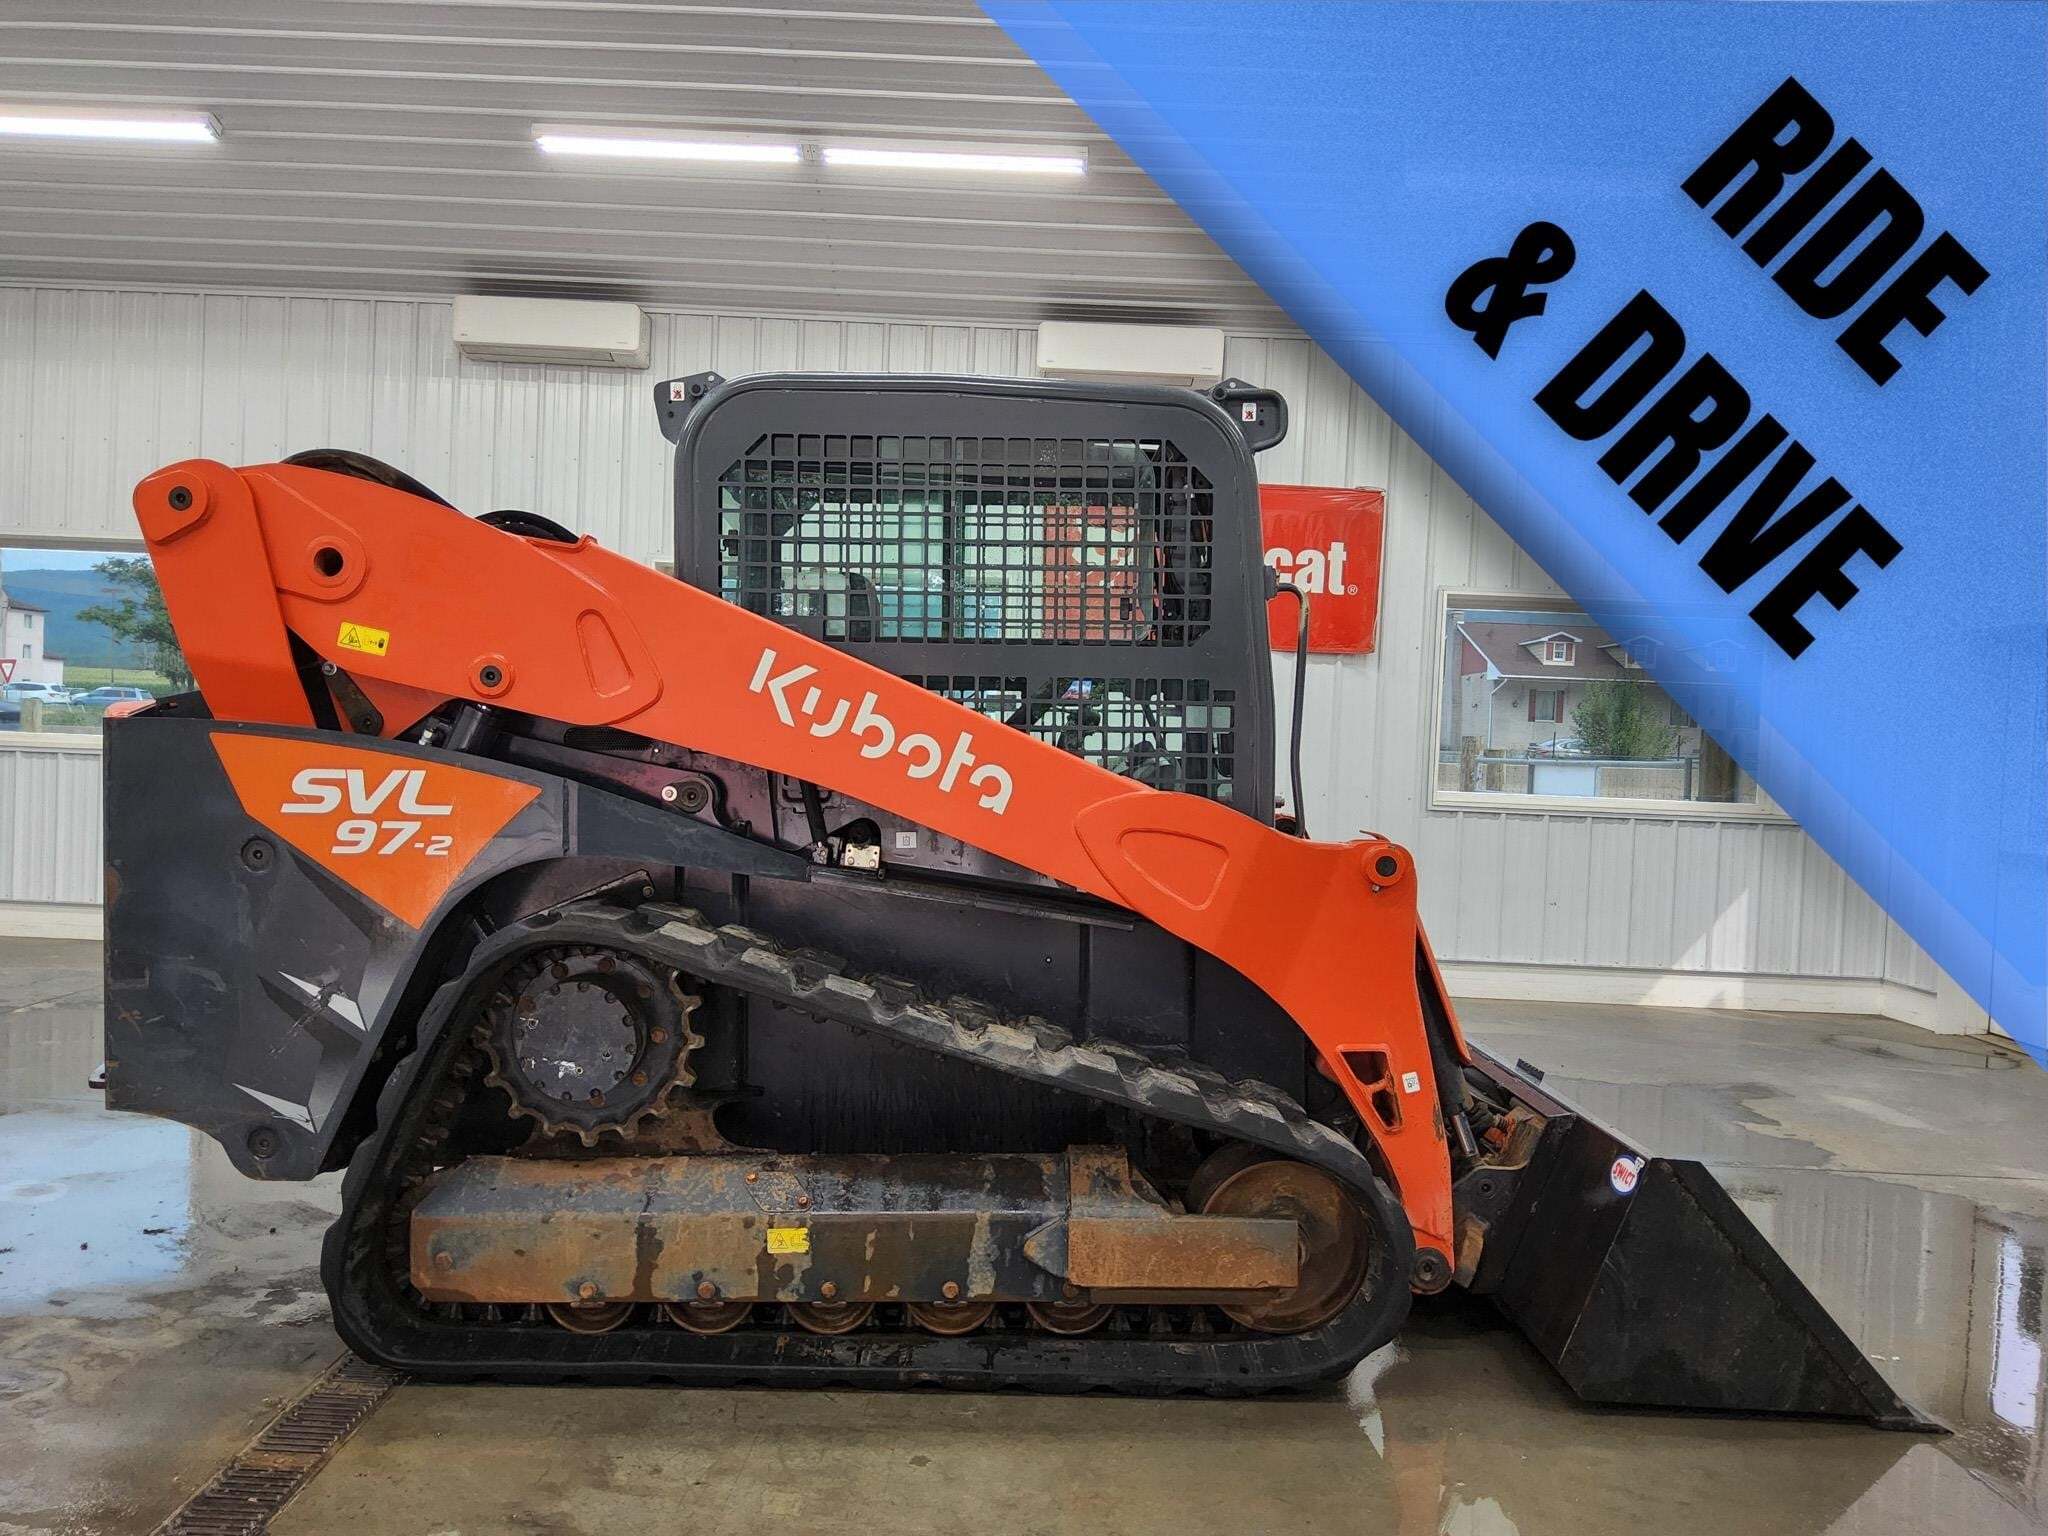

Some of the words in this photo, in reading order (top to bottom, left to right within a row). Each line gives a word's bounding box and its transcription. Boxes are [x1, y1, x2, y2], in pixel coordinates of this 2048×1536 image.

[749, 647, 1013, 815] Kubota
[280, 768, 453, 815] SVL
[331, 819, 453, 855] 97-2
